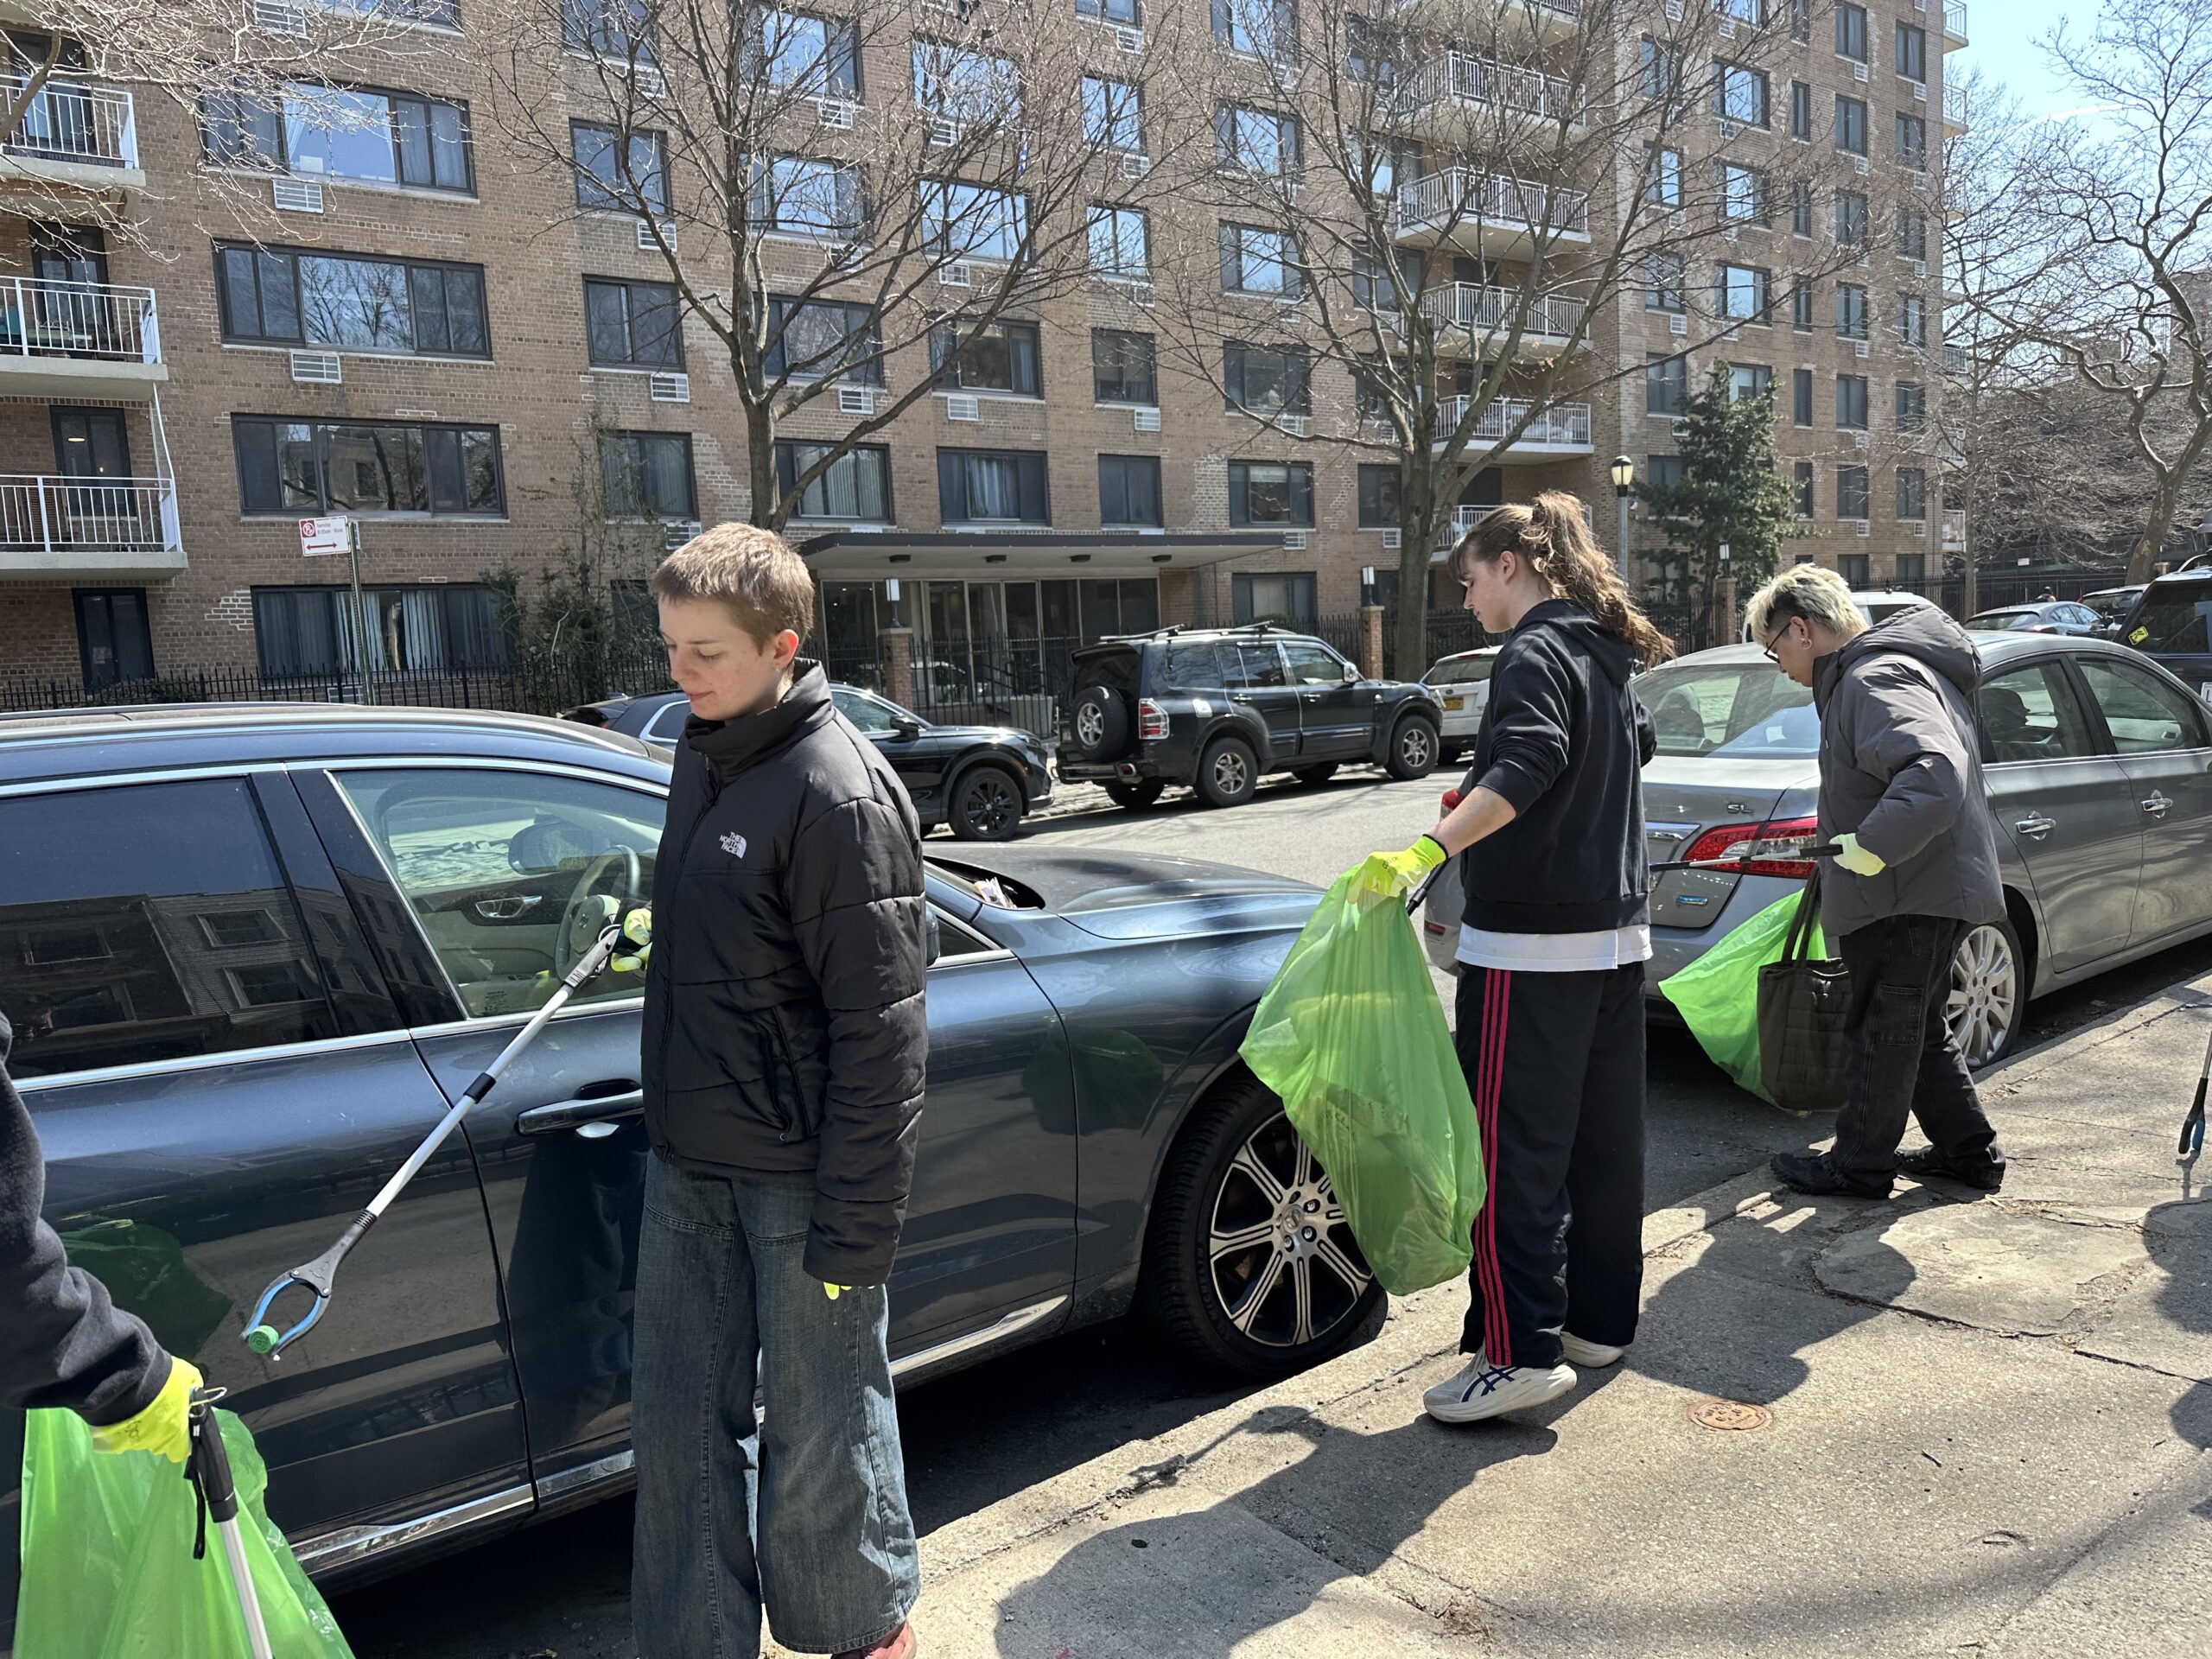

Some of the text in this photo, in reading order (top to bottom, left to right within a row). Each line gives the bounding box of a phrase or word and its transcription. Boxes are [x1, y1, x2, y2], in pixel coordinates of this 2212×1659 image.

[1727, 804, 1753, 815] SL
[719, 835, 740, 848] NORTH
[730, 831, 741, 842] THE
[721, 843, 738, 854] FACE
